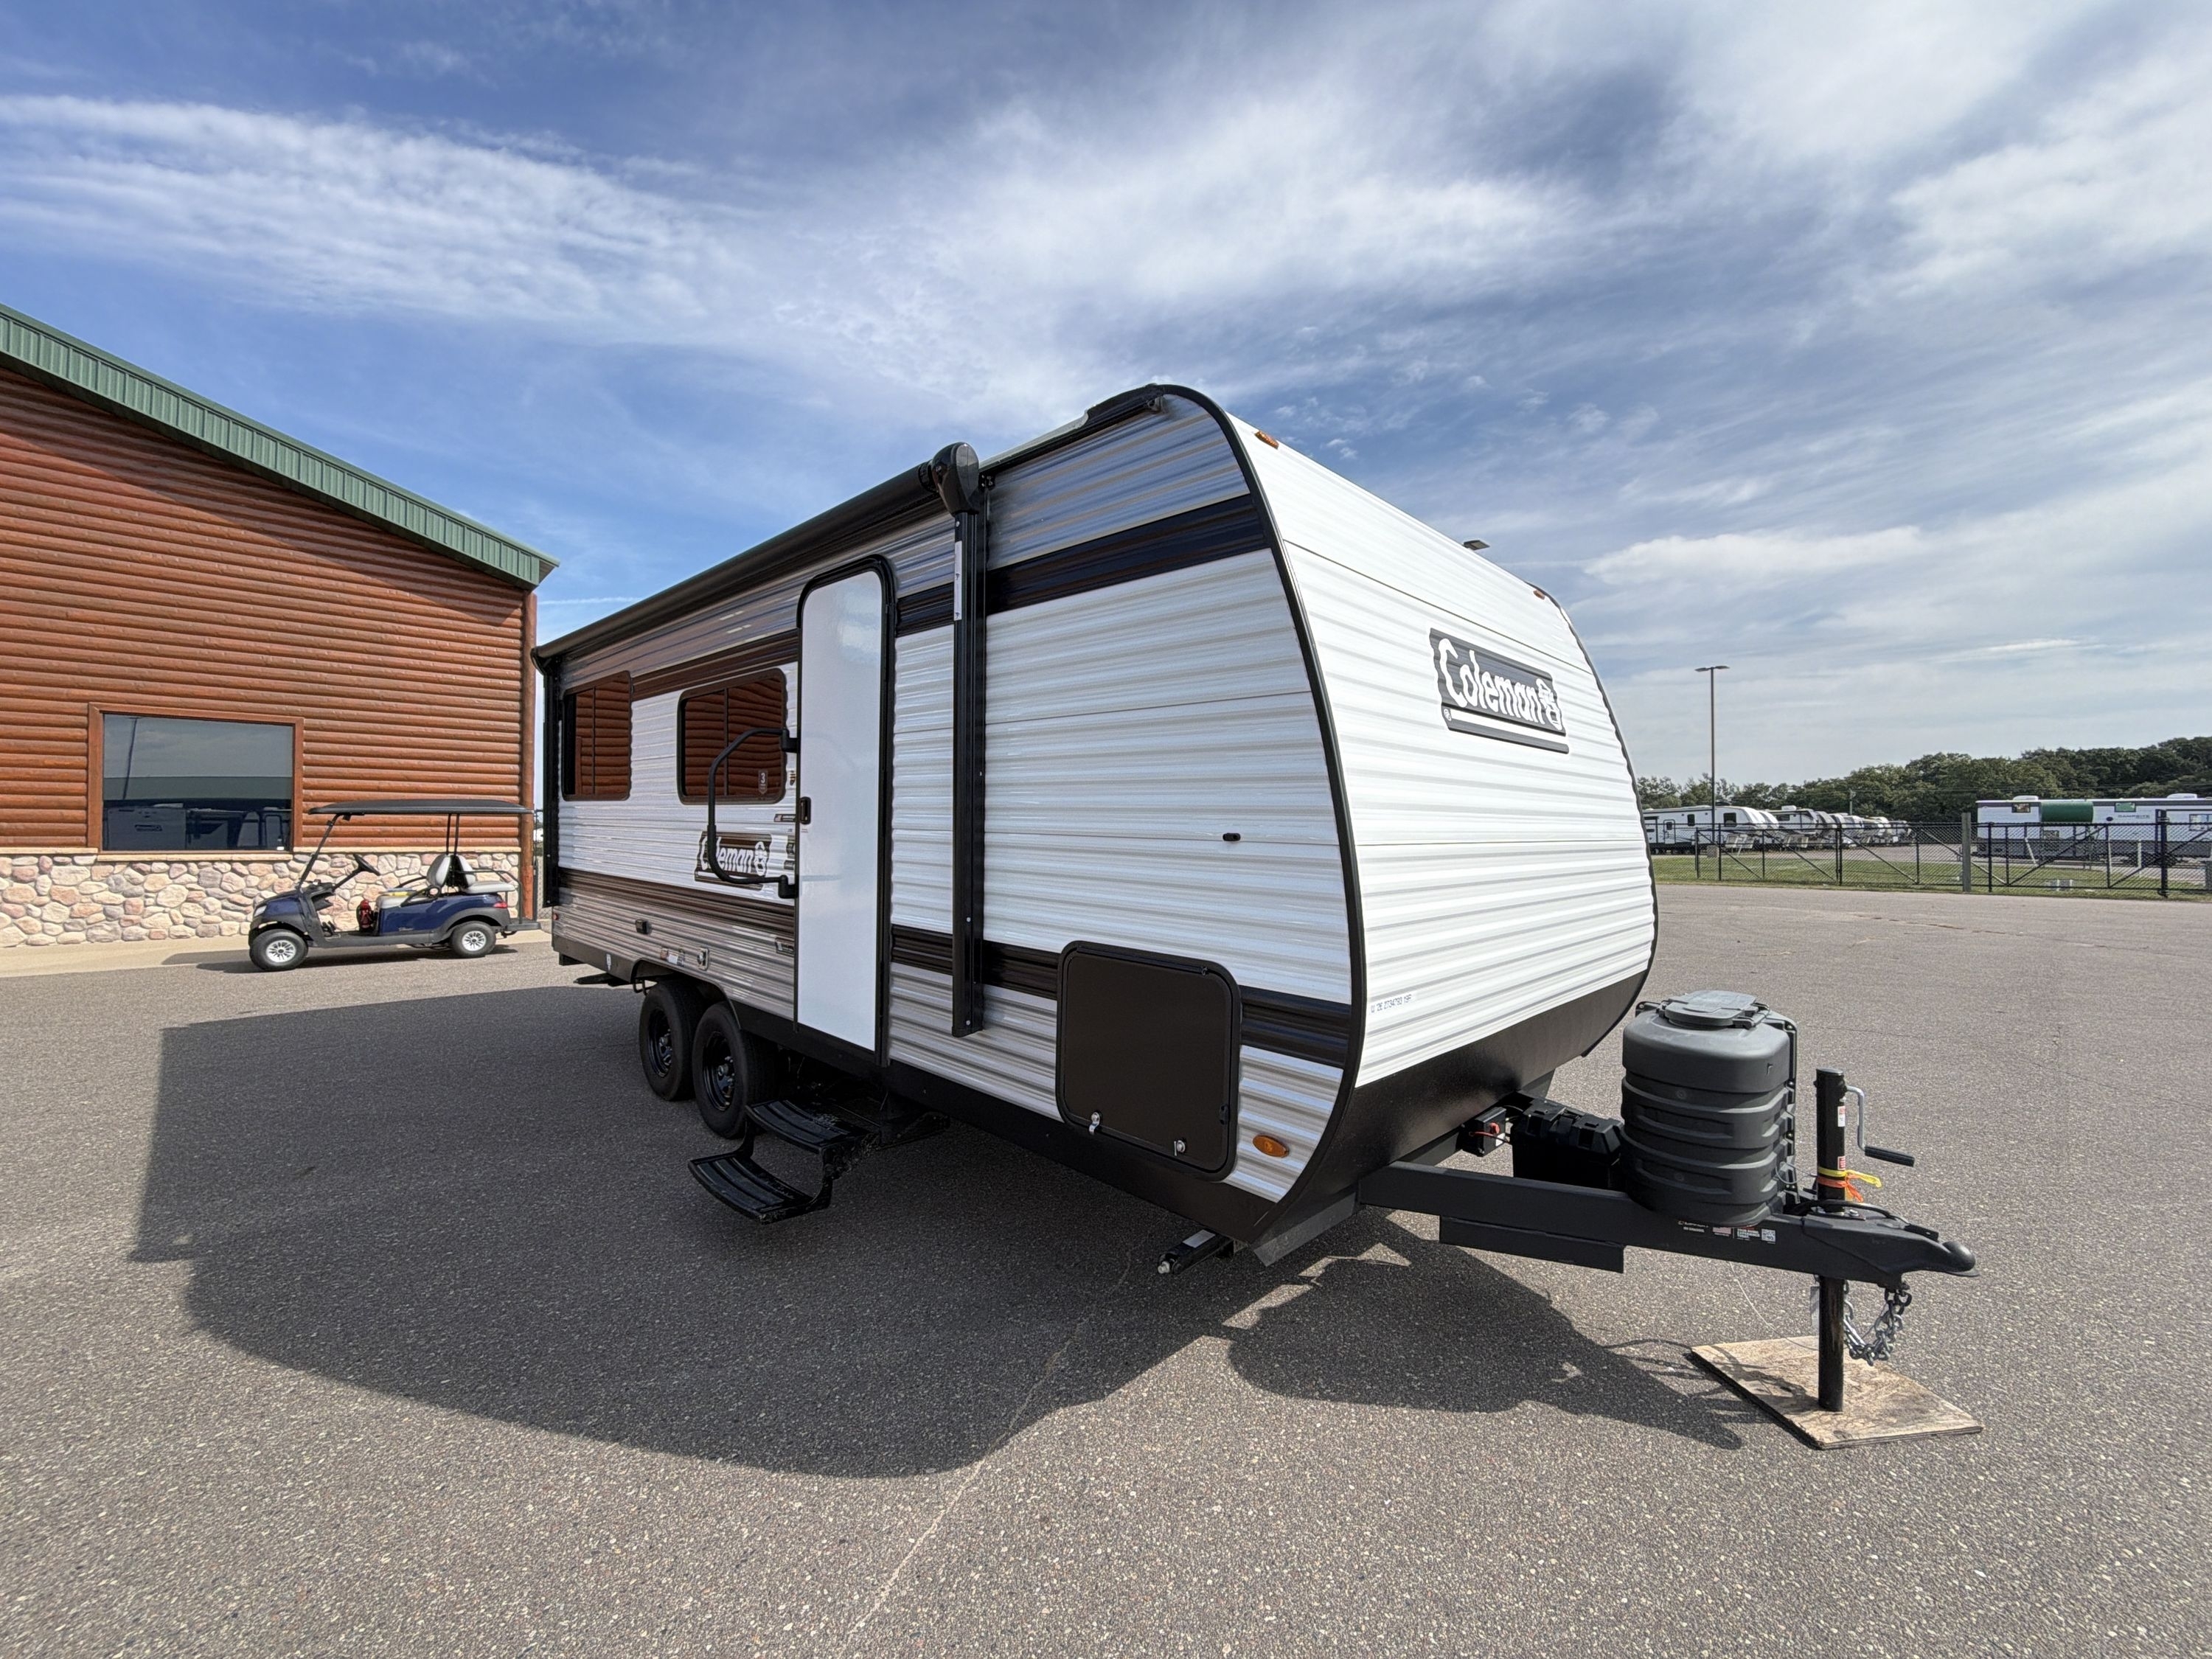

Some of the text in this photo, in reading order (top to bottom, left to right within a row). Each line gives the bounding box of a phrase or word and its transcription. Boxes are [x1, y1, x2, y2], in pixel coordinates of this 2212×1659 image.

[1439, 638, 1545, 725] Coleman
[760, 772, 766, 784] 3
[700, 836, 754, 874] Cleman
